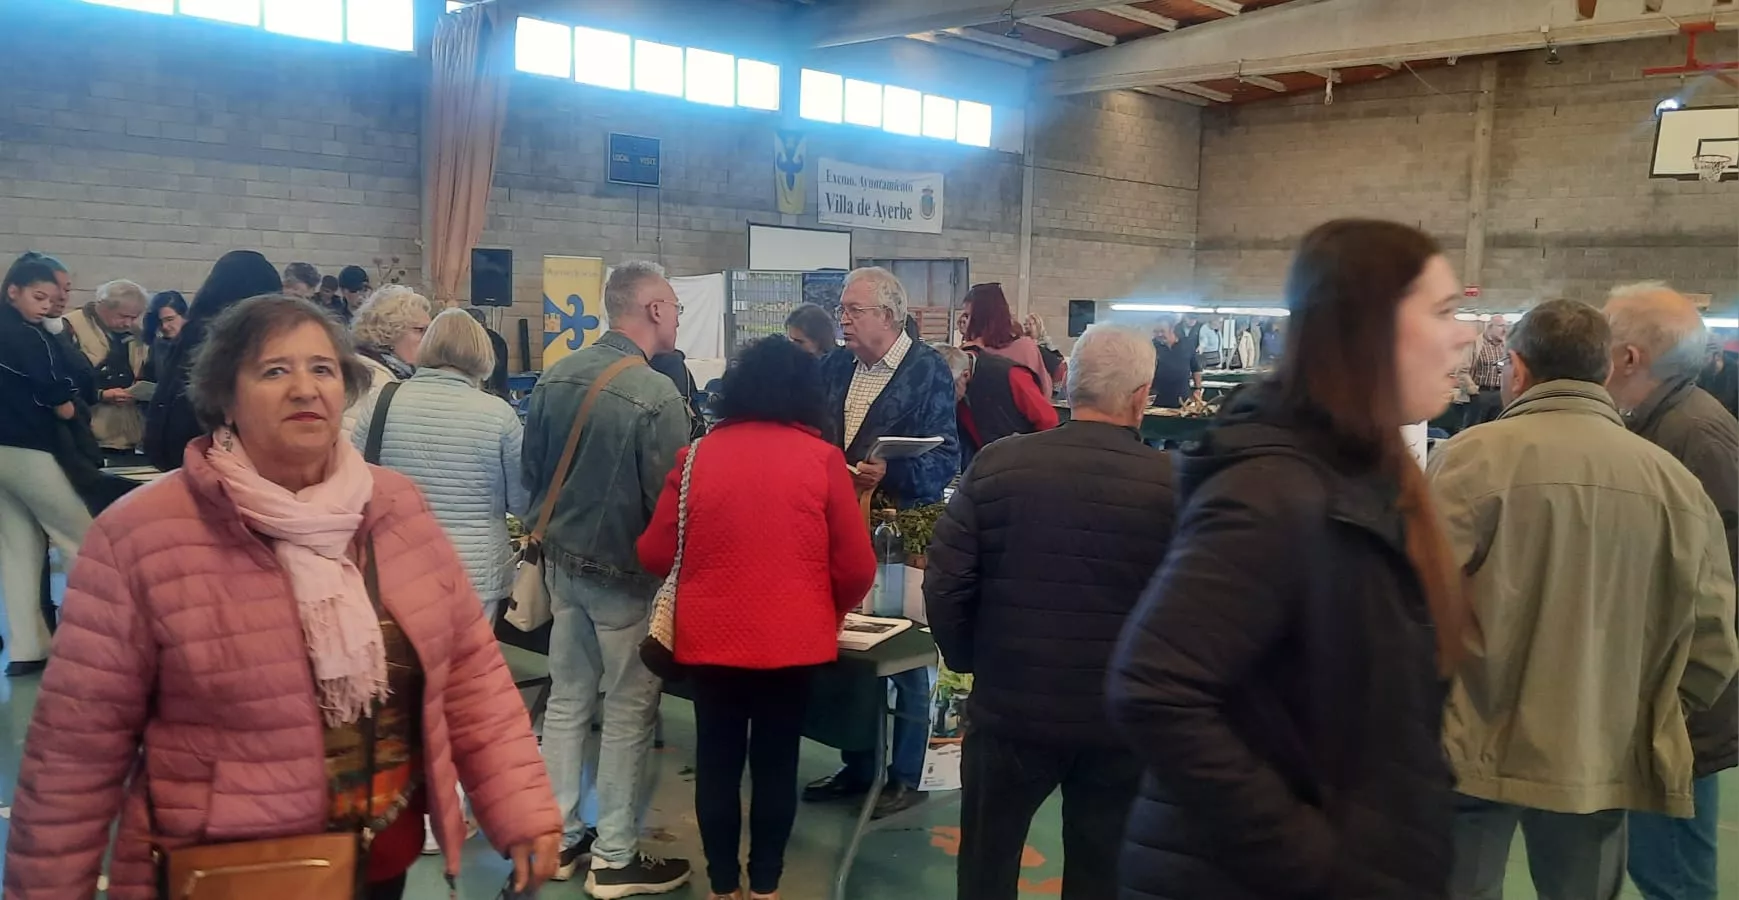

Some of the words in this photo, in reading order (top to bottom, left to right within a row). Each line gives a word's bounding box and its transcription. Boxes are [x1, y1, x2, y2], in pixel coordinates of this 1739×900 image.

[826, 169, 857, 187] Excmo.
[860, 175, 913, 193] Ayuntamiento
[825, 192, 854, 214] Villa
[857, 197, 871, 217] de
[873, 200, 913, 224] Ayerbe
